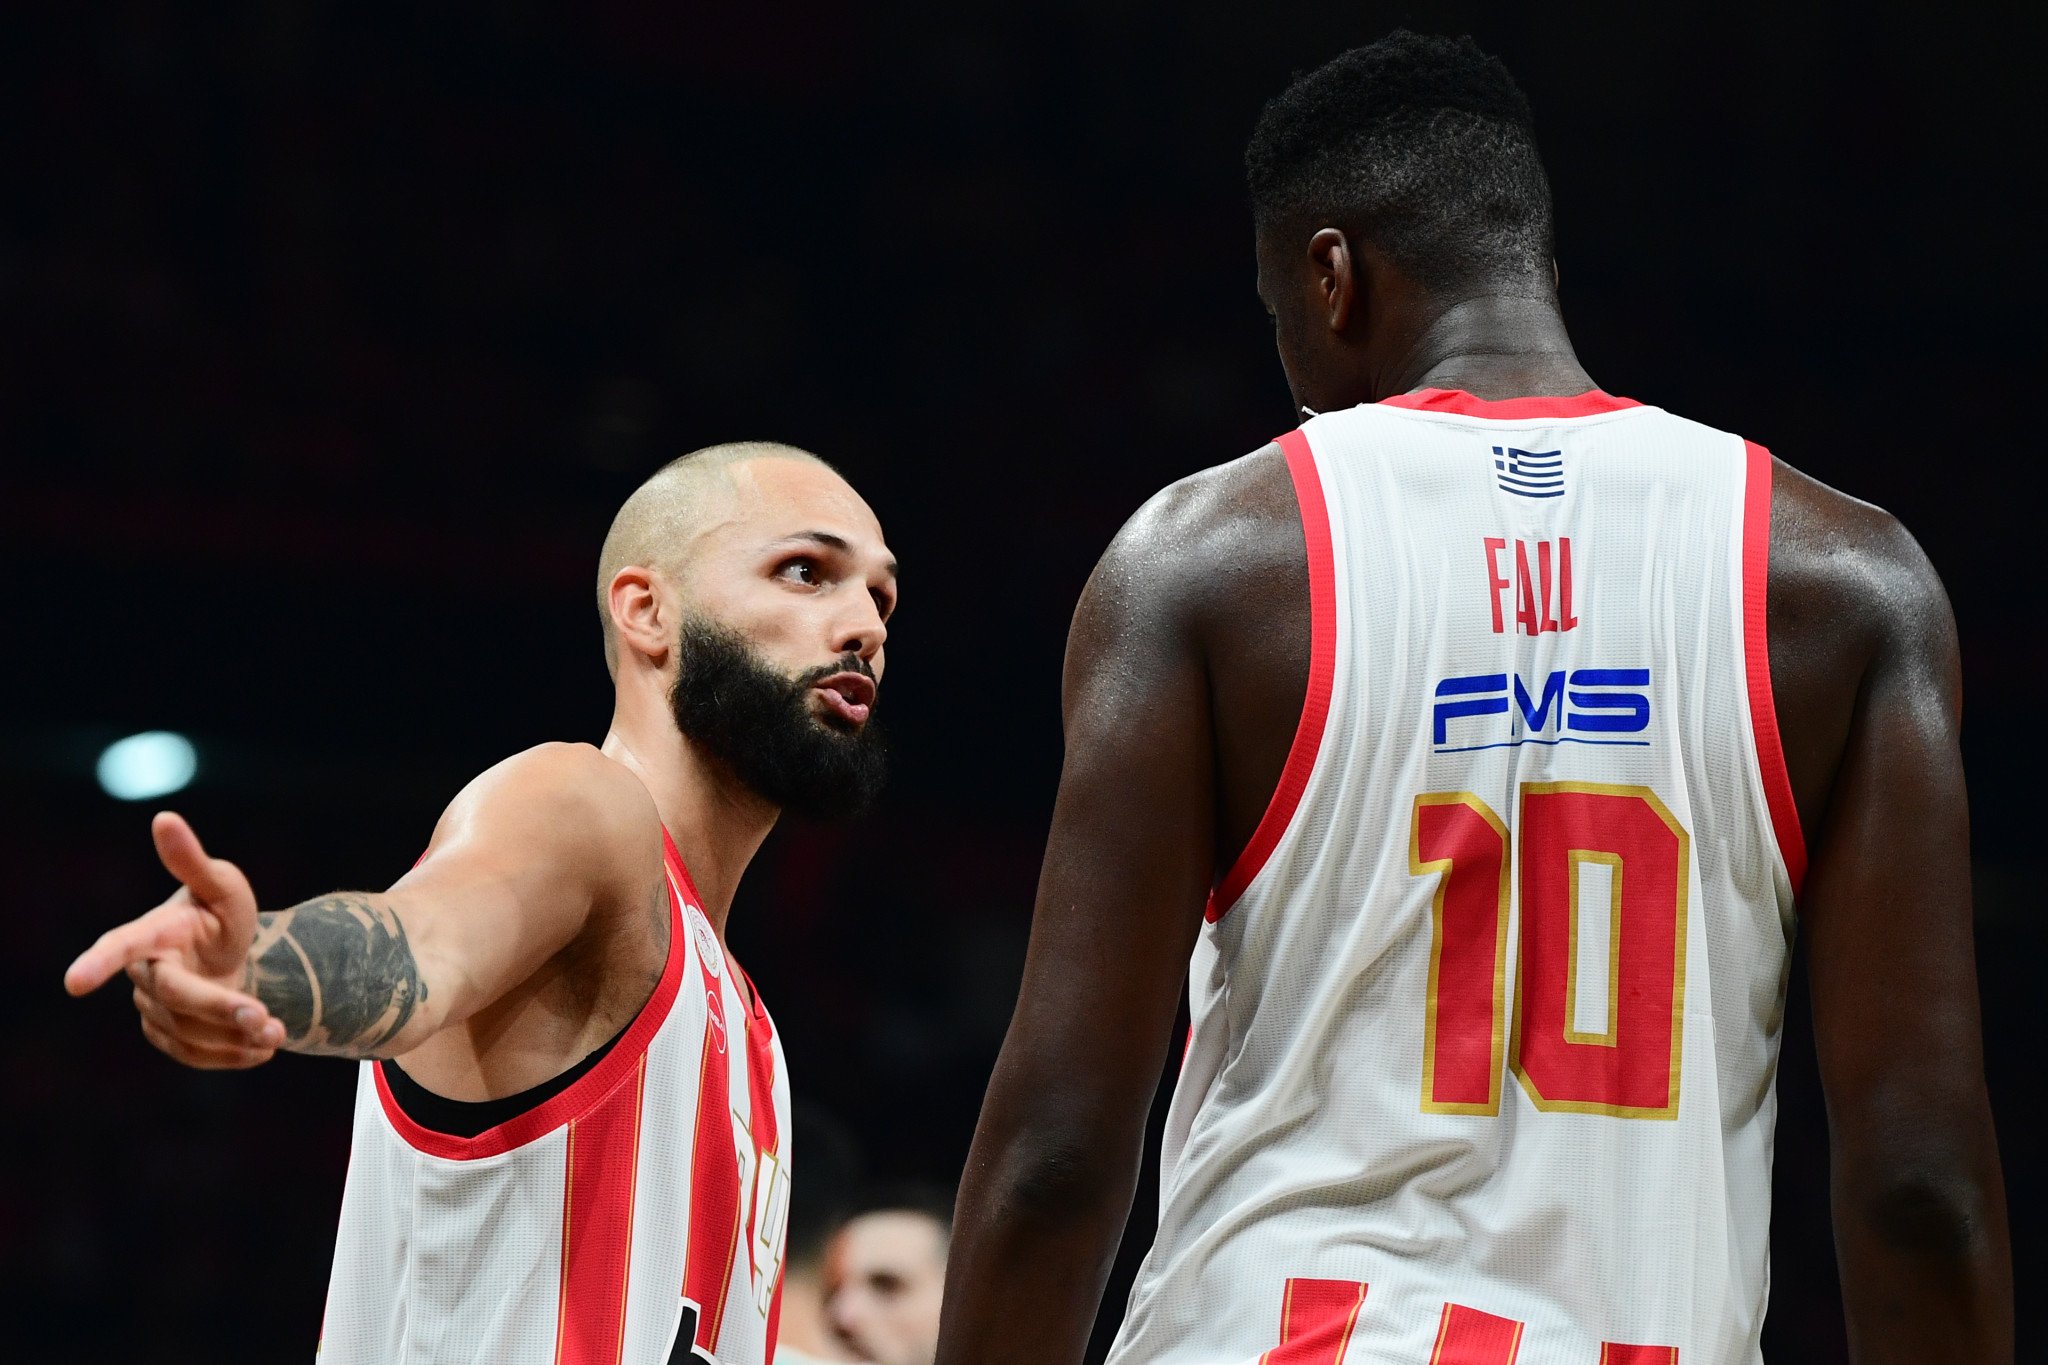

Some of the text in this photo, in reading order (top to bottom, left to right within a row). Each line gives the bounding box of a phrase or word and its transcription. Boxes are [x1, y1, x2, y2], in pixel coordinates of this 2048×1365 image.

[1483, 537, 1578, 637] FALL
[1433, 668, 1650, 745] FMS
[1408, 780, 1690, 1121] 10
